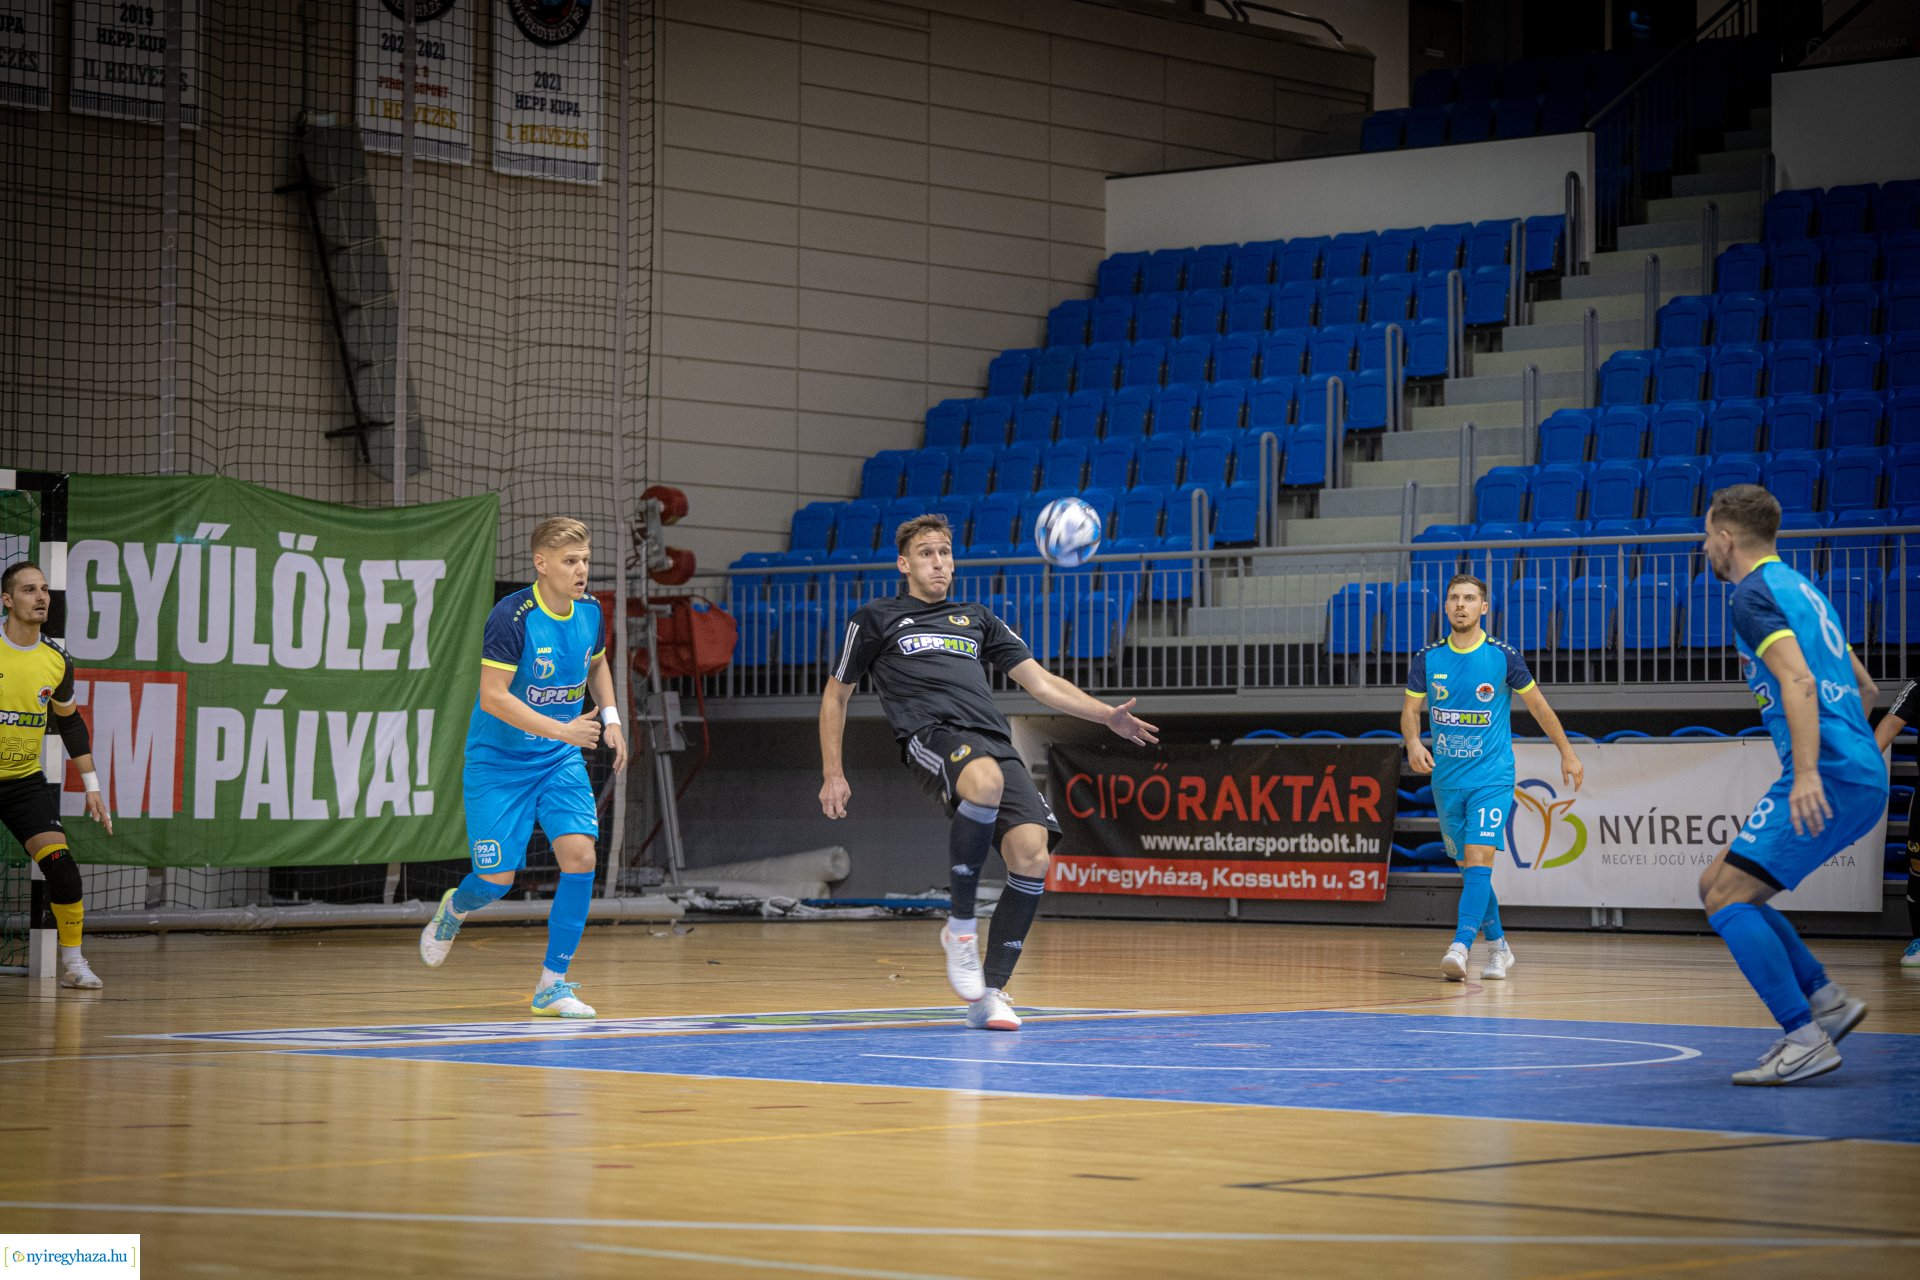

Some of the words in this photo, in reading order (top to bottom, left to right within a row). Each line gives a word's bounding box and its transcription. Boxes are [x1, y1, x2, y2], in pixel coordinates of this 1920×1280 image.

[119, 3, 154, 26] 2019
[96, 27, 135, 48] HEPP
[138, 34, 165, 53] KUP
[104, 61, 188, 92] HELYEZS
[534, 71, 561, 91] 2021
[515, 93, 547, 112] HEPP
[549, 98, 581, 117] KUPA
[64, 521, 447, 671] GYŰLÖLET
[1799, 582, 1845, 660] 8
[61, 678, 180, 819] EM
[193, 687, 437, 820] PÁLYA!
[1435, 746, 1483, 758] STUDIO
[1065, 762, 1383, 823] CIPŐRAKTÁR
[1477, 807, 1504, 829] 19
[1599, 807, 1749, 845] NYÍREGY
[1747, 797, 1776, 829] 8
[1141, 831, 1380, 857] www.raktarsportbolt.hu
[1480, 830, 1496, 838] JAKO
[477, 843, 496, 854] 99.4
[1601, 854, 1647, 866] MEGYEI
[1652, 852, 1686, 867] JOGÚ
[1690, 853, 1713, 866] VÁR
[1055, 861, 1209, 891] Nyíregyháza,
[1212, 867, 1316, 889] Kossuth
[1322, 874, 1344, 890] u.
[1348, 869, 1386, 891] 31.
